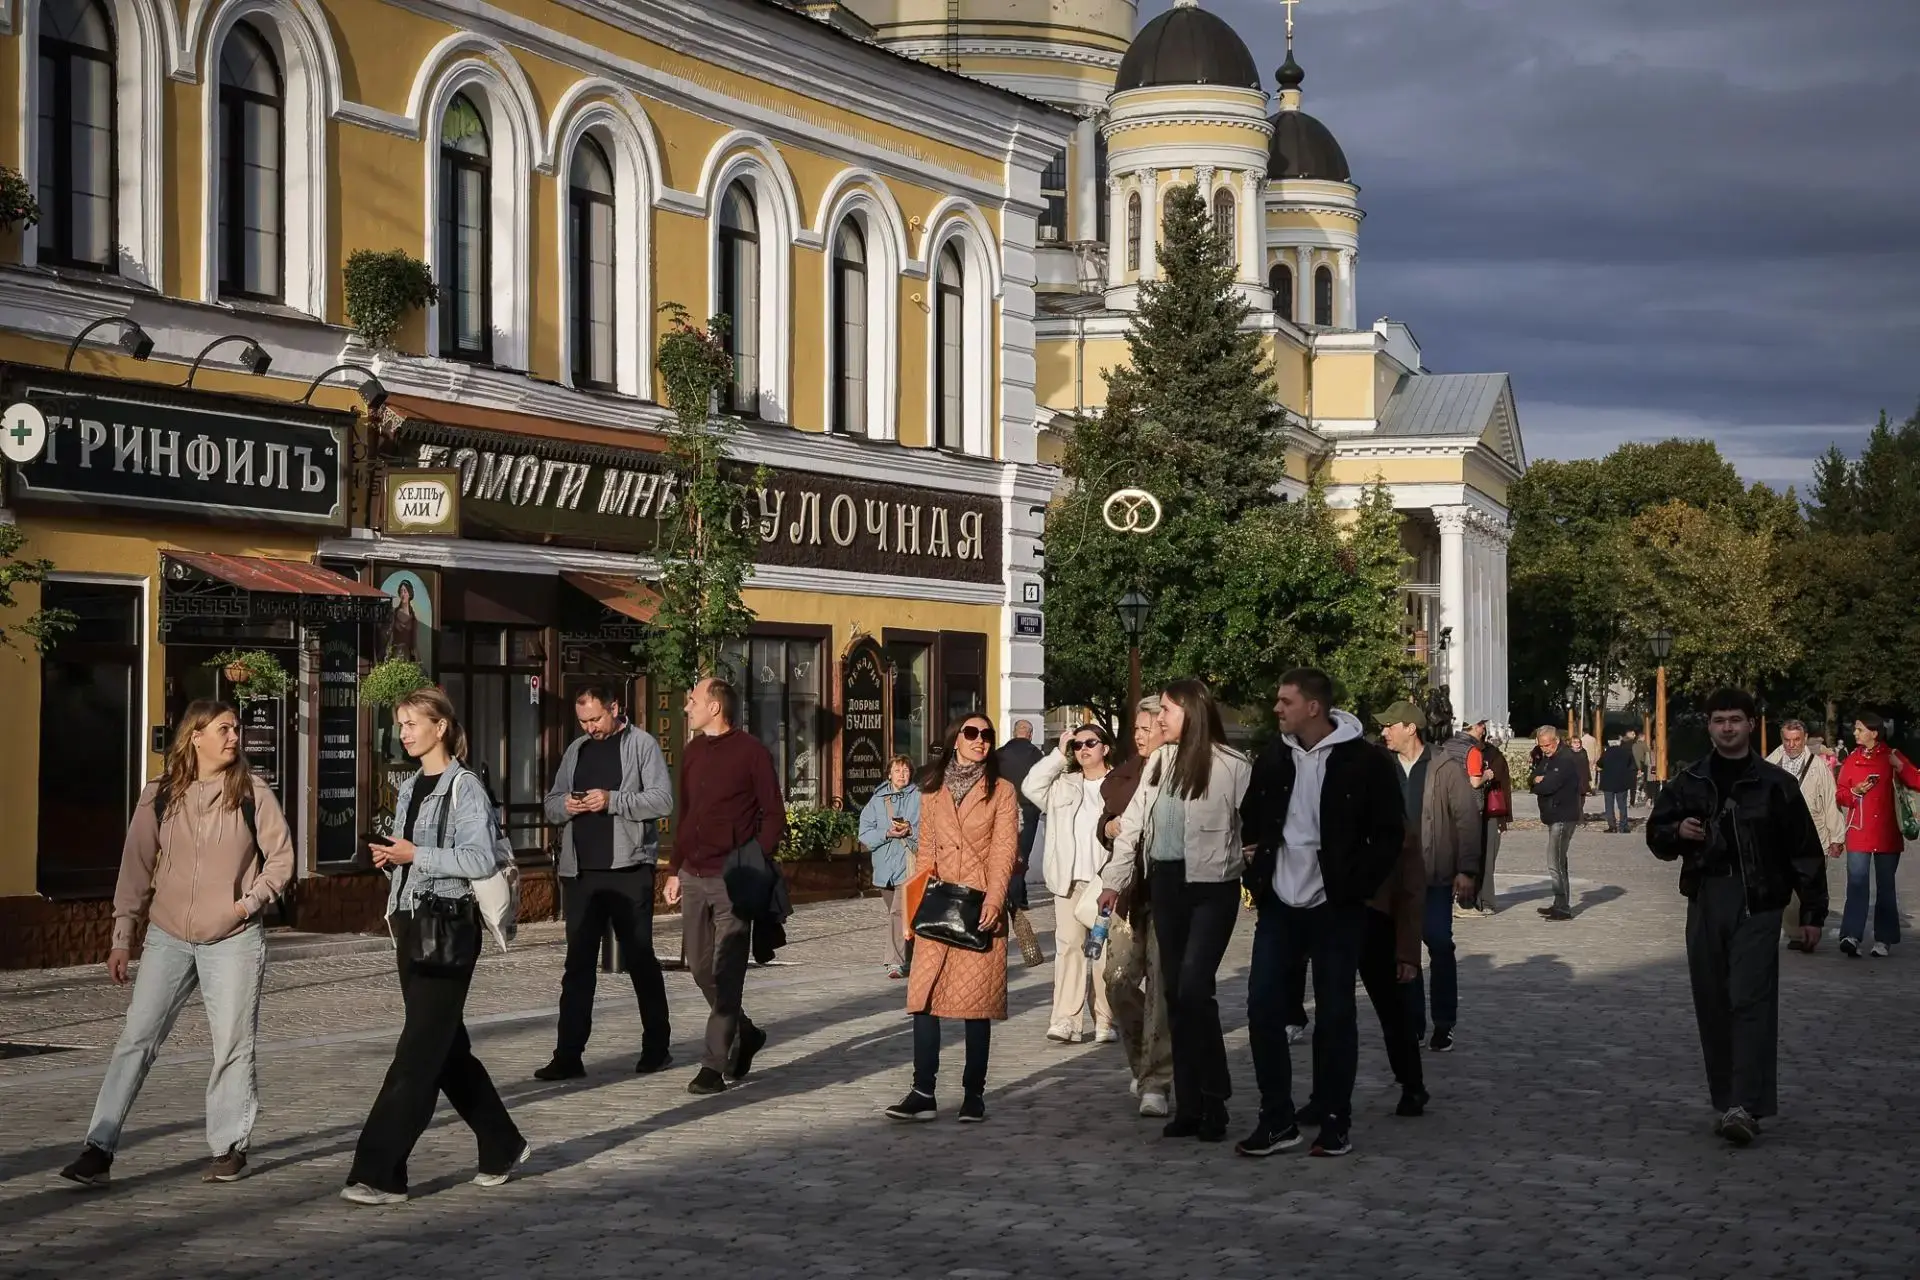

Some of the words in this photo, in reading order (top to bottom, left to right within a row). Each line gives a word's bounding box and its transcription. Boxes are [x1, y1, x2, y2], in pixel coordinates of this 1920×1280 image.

[399, 486, 439, 500] ХЕЛПЪ
[1028, 587, 1035, 598] 4
[846, 713, 882, 730] БУЛКИ
[319, 787, 355, 799] АЧЕСТВЕННЫЙ
